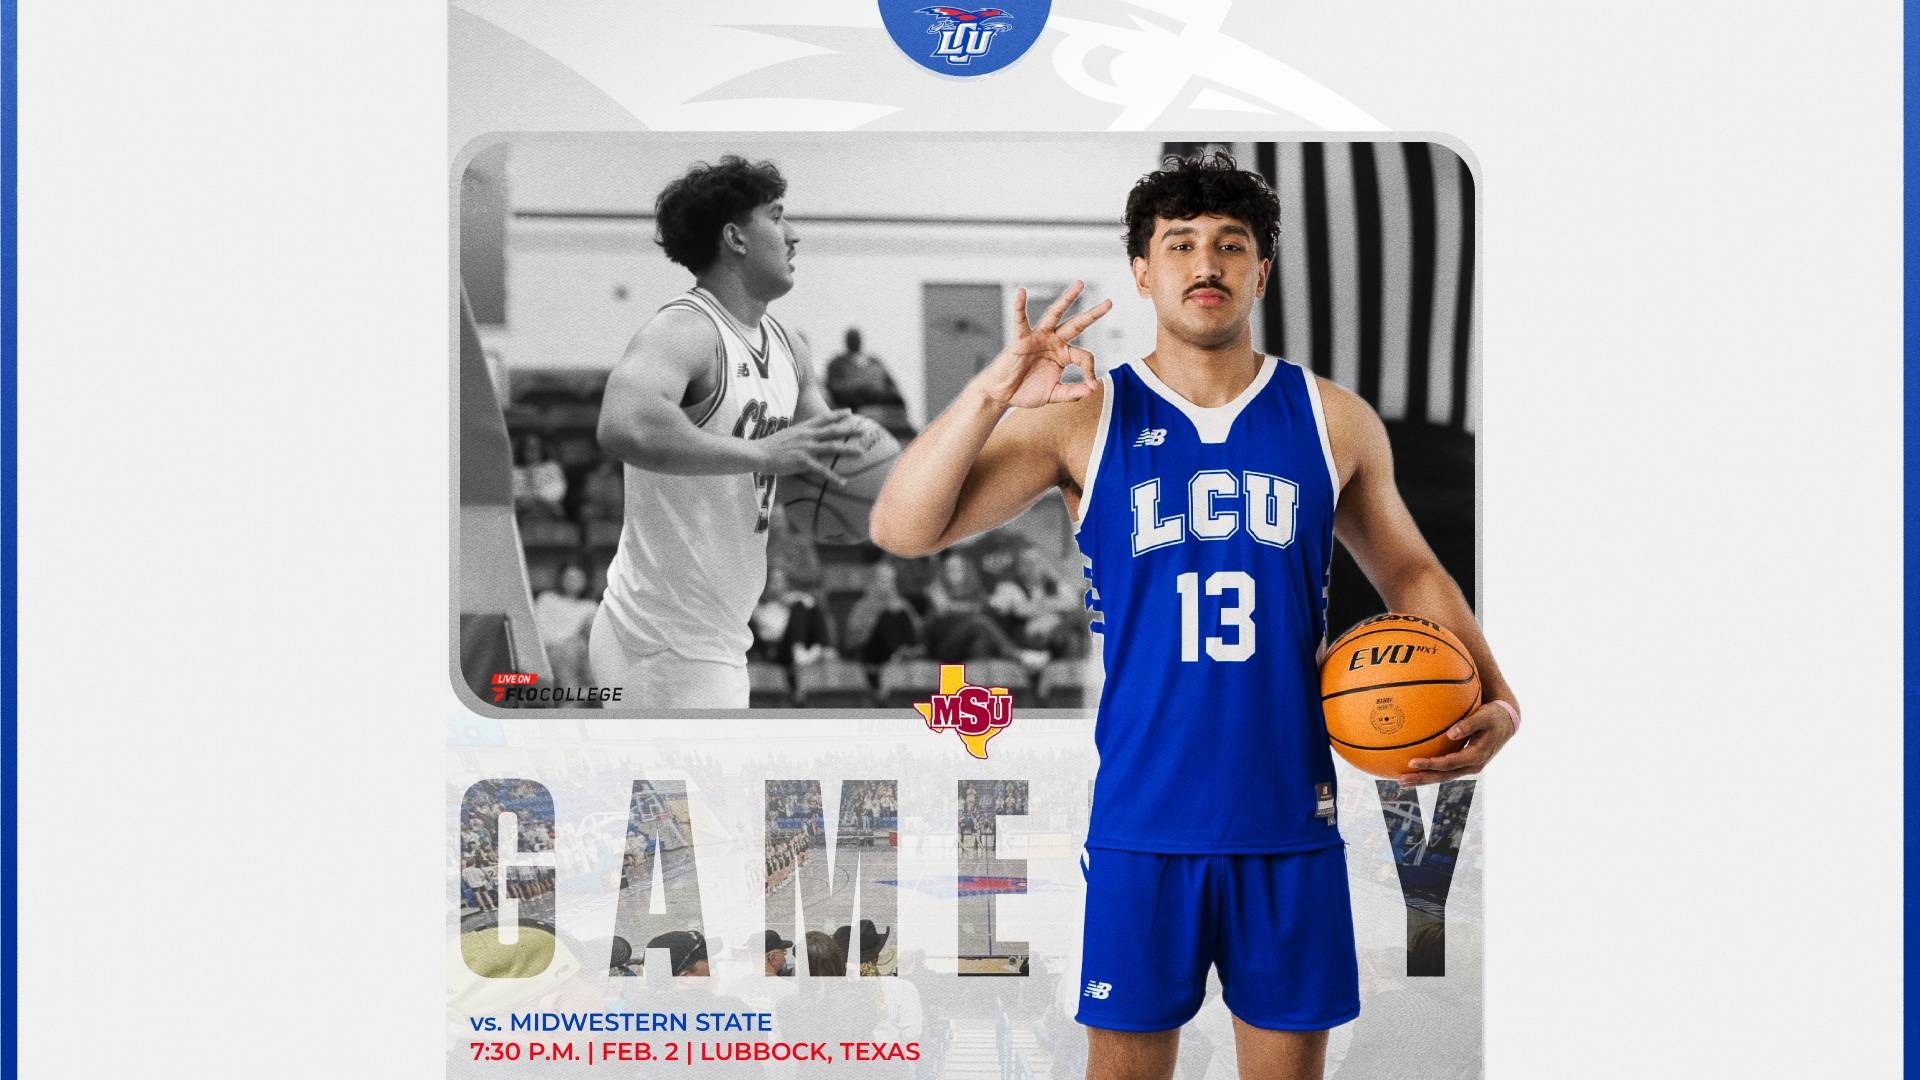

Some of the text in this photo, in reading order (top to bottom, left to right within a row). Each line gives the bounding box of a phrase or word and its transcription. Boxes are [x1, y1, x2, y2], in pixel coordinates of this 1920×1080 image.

[1131, 469, 1299, 558] LCU
[1176, 571, 1256, 662] 13
[1348, 644, 1415, 672] EVO
